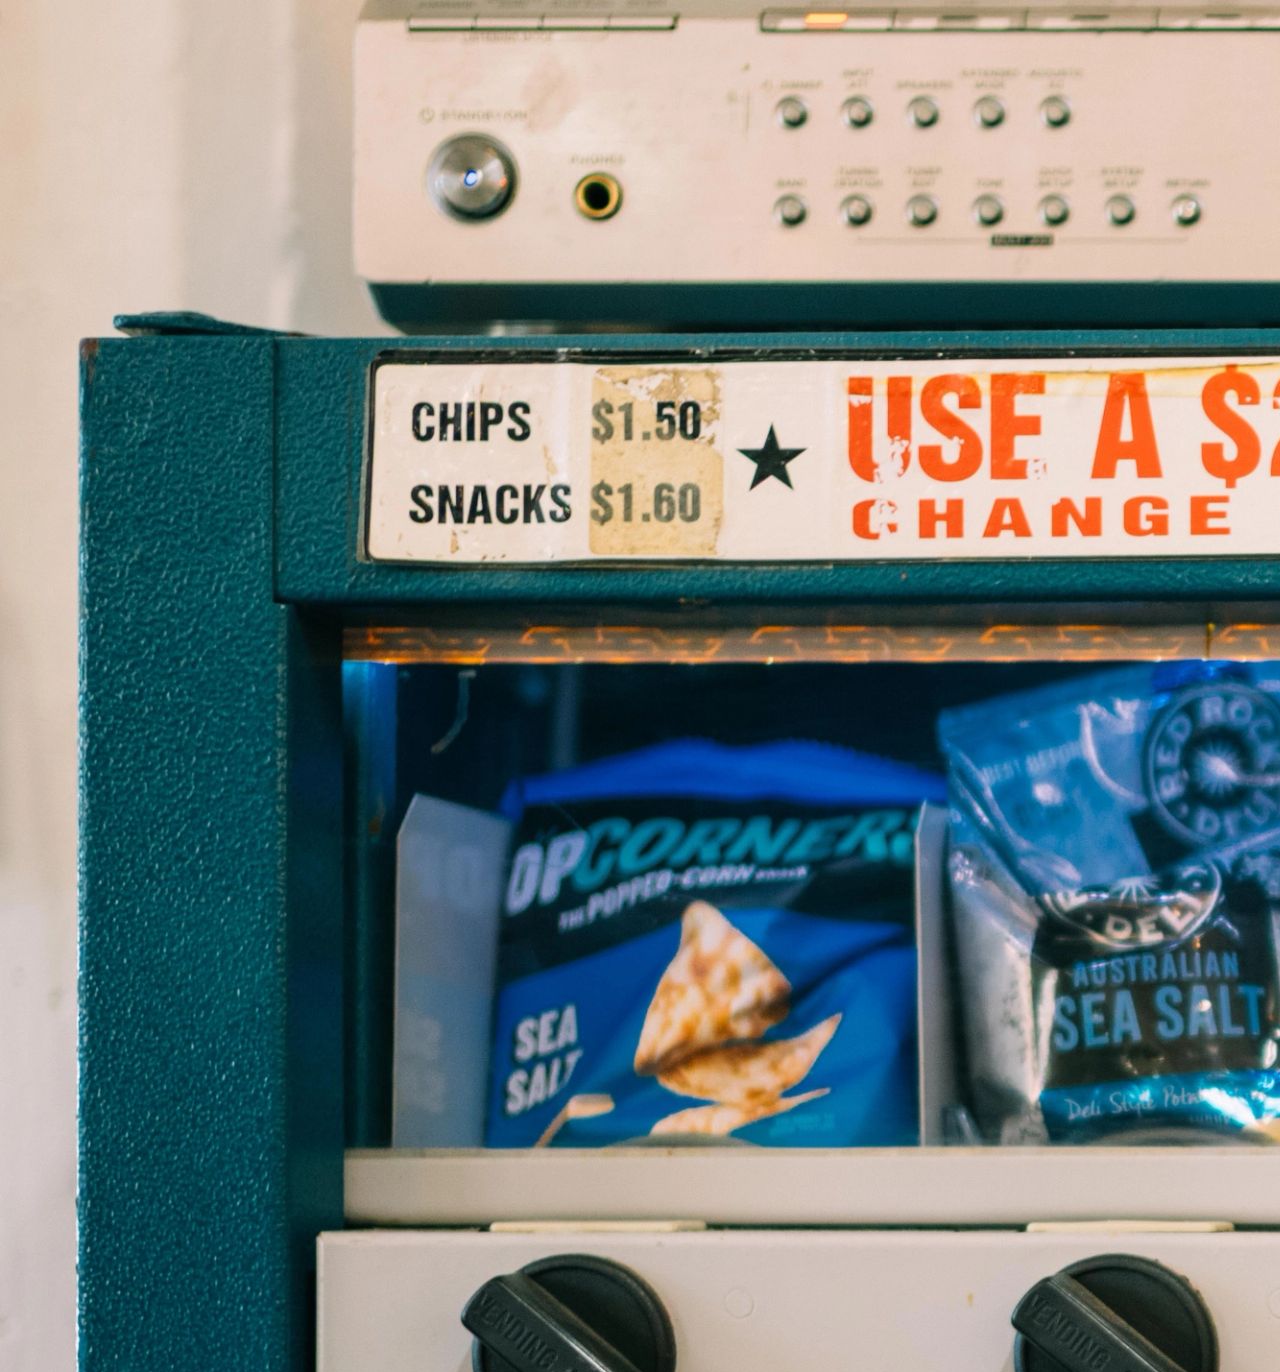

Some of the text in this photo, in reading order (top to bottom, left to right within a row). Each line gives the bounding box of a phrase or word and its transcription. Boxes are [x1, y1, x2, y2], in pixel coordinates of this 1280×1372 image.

[411, 399, 702, 444] CHIPS $1.50
[847, 373, 1048, 483] USE
[1090, 371, 1164, 480] A
[408, 481, 701, 526] SNACKS $1.60
[851, 494, 1237, 541] CHANGE
[1071, 951, 1240, 989] AUSTRALIAN
[514, 1005, 578, 1063] SEA
[1053, 984, 1266, 1052] SEA SALT
